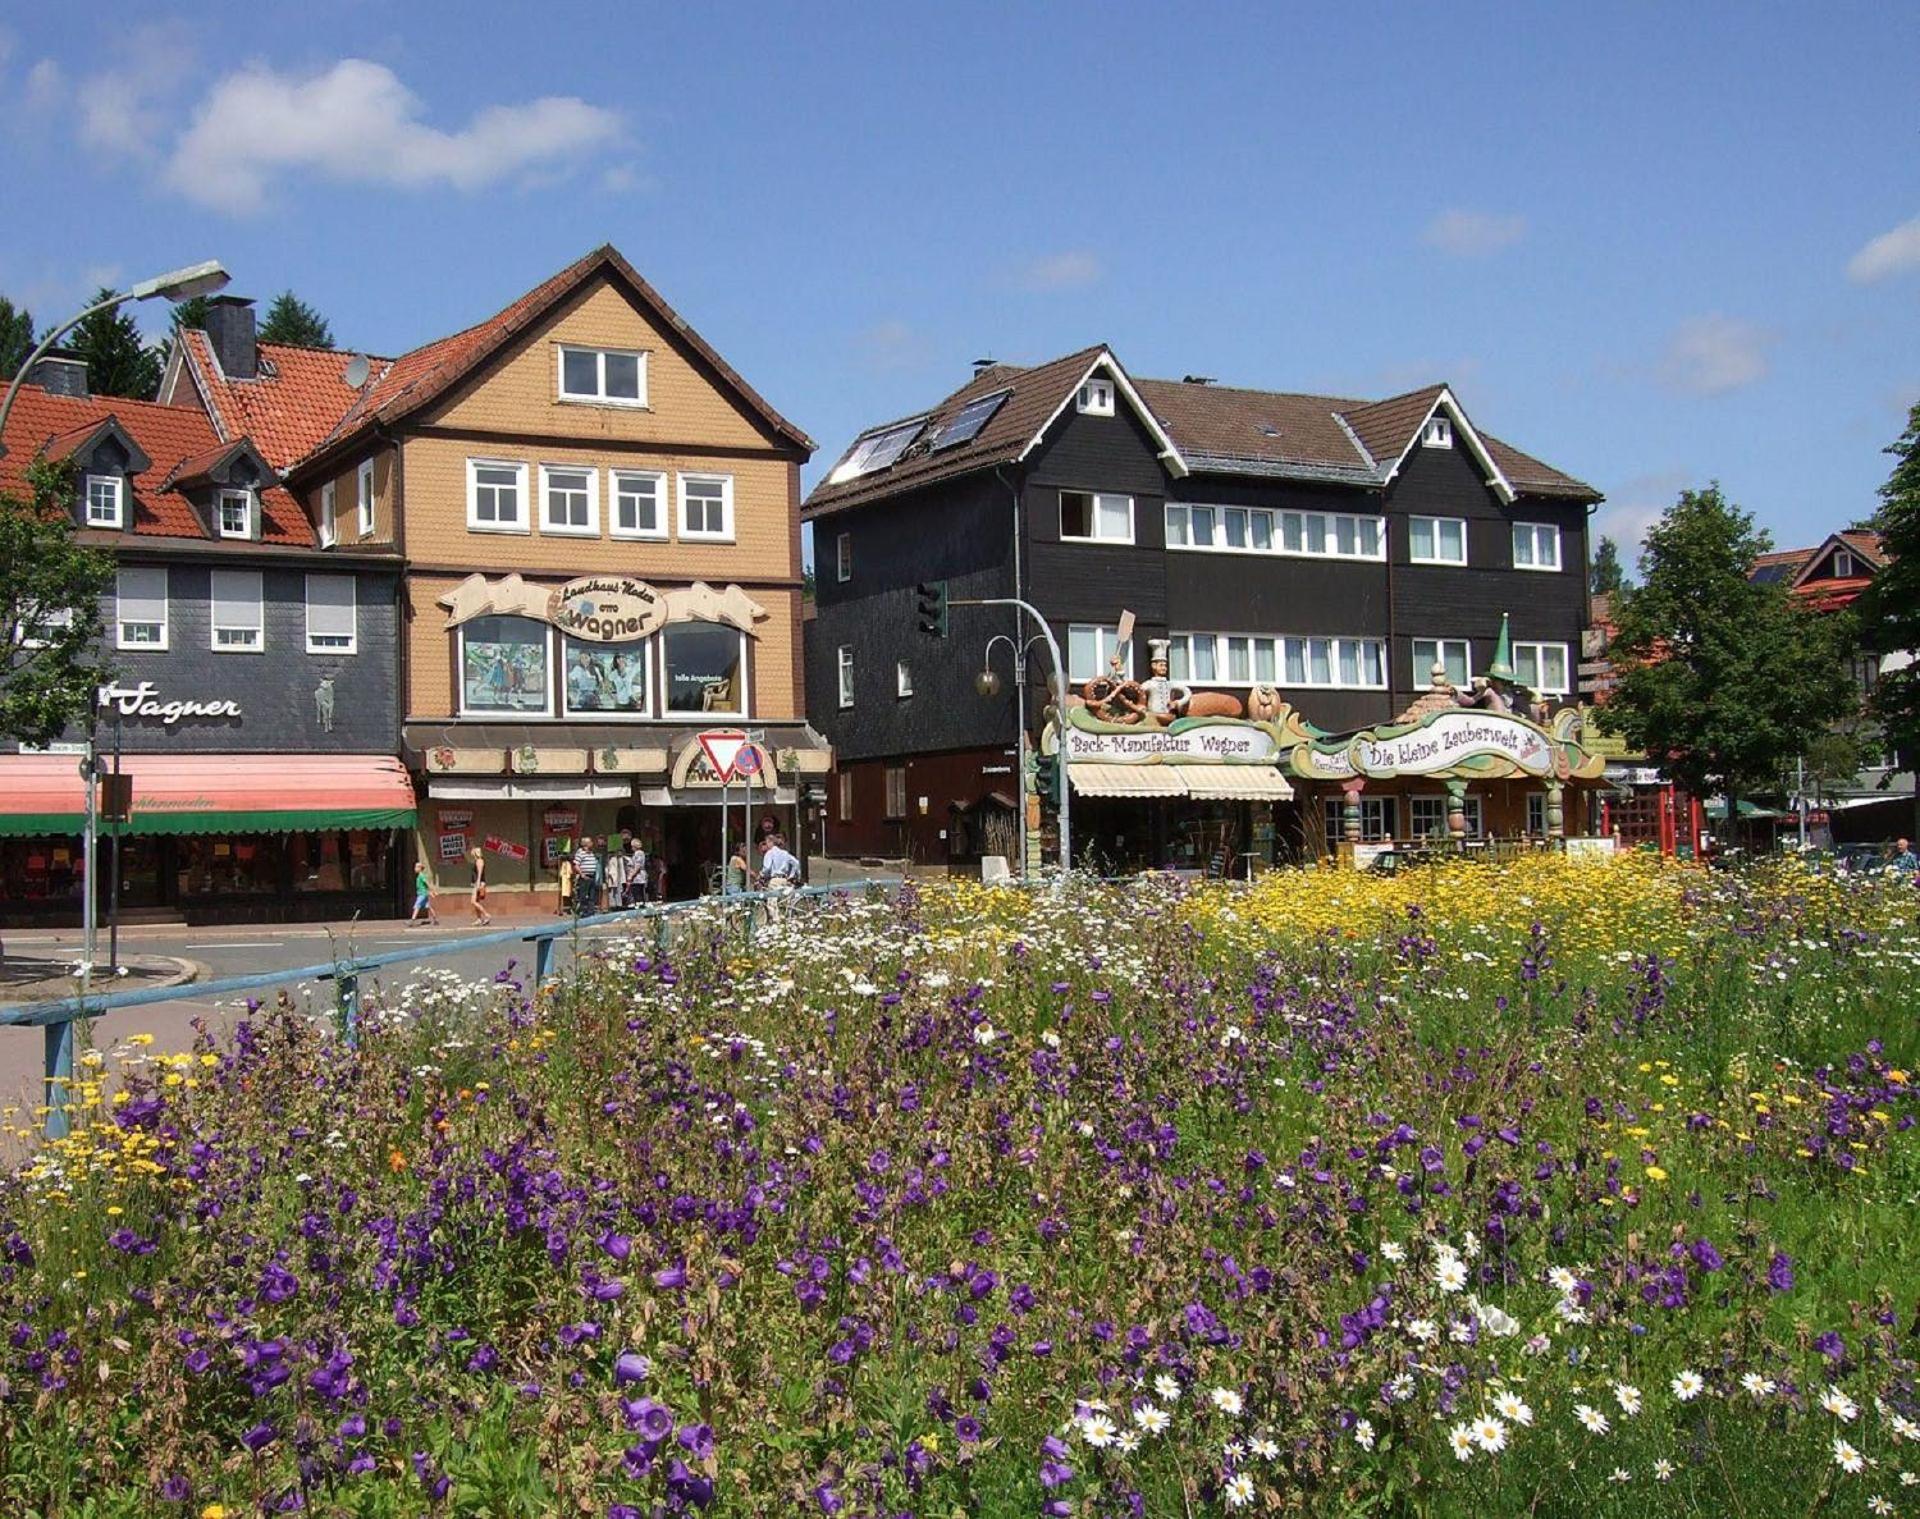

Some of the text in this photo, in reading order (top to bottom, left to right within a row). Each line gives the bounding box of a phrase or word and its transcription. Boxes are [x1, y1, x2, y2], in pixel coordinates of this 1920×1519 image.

[1200, 735, 1250, 756] Wagner
[1370, 747, 1395, 766] Die
[1398, 738, 1439, 765] kleine
[1441, 722, 1518, 751] Zauberwelt
